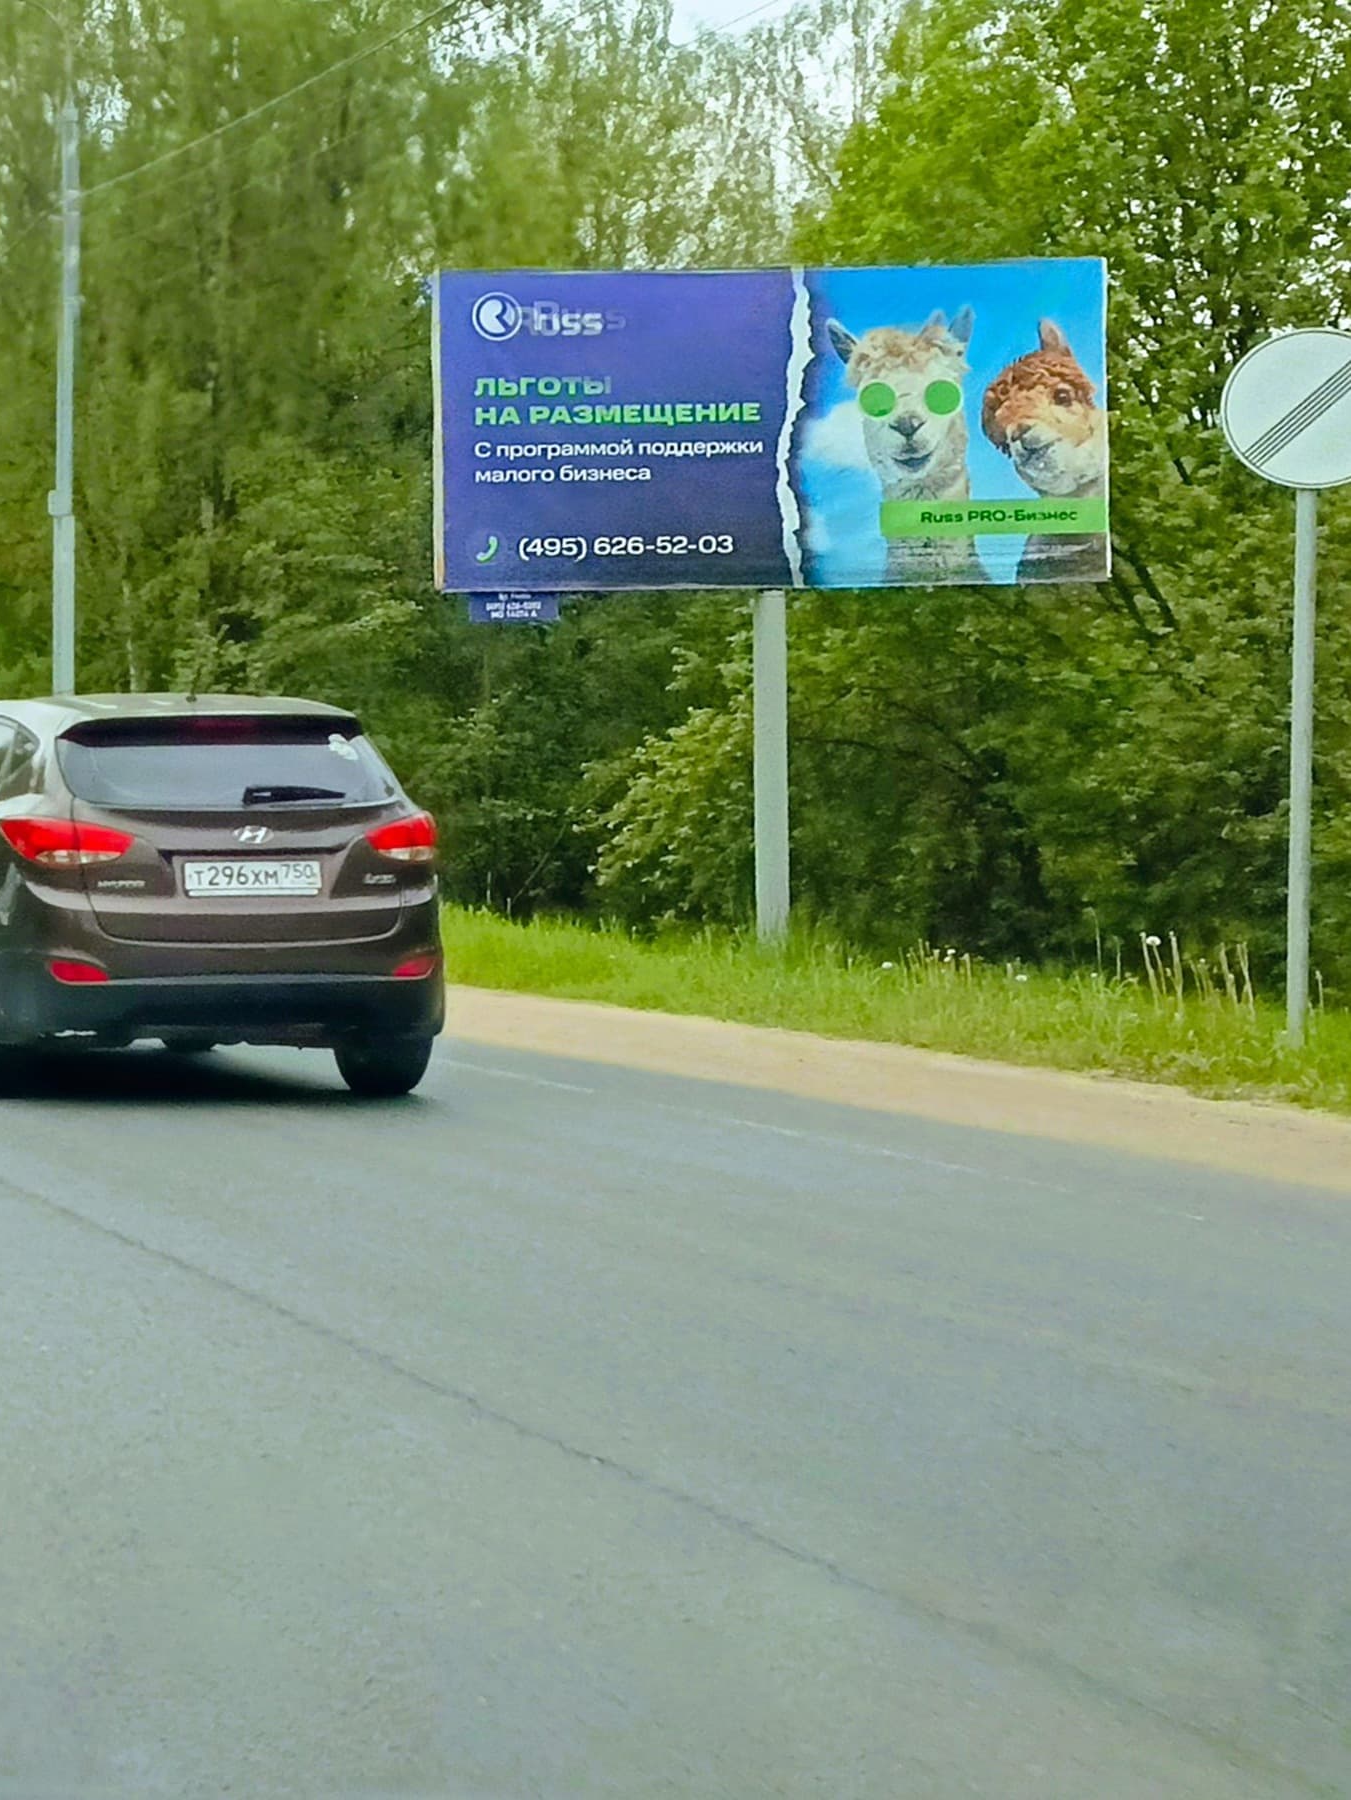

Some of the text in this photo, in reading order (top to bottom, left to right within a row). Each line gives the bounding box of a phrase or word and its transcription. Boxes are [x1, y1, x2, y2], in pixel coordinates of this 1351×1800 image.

[474, 376, 612, 397] ЛЬГОТЫ
[475, 402, 762, 426] НА РАЗМЕЩЕНИЕ
[474, 439, 764, 460] С программой поддержки
[475, 465, 651, 483] малого бизнеса
[920, 511, 963, 523] Russ
[518, 535, 734, 562] (495) 626-52-03
